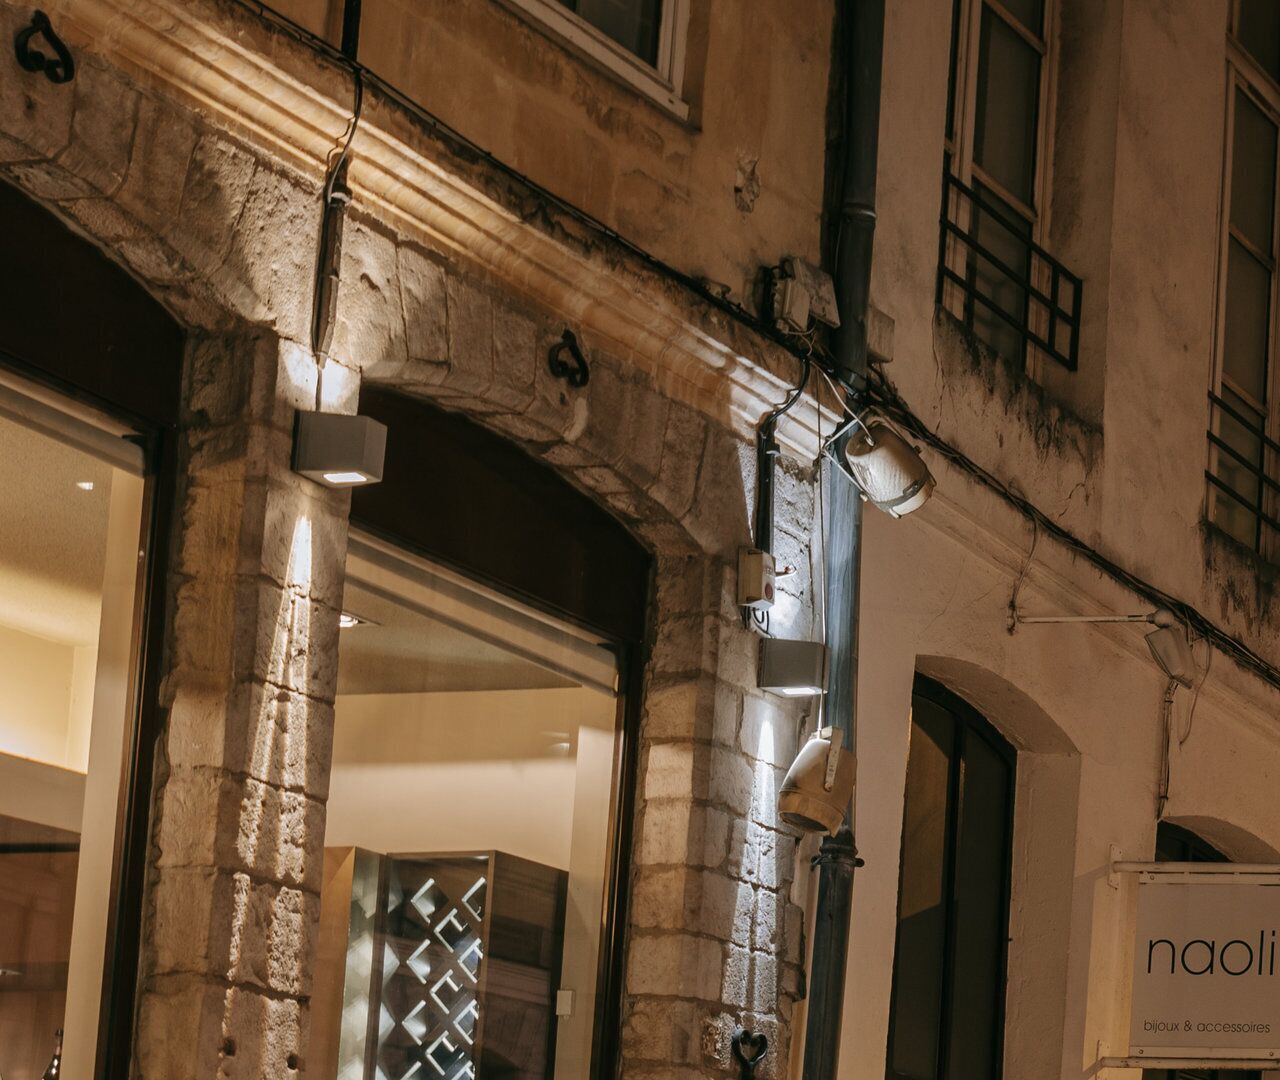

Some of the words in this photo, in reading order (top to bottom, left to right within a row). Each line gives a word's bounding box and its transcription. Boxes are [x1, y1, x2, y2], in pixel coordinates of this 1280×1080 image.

[1146, 928, 1277, 977] naoli
[1143, 1020, 1180, 1034] bijoux
[1183, 1020, 1193, 1032] &
[1196, 1021, 1271, 1034] accessoires
